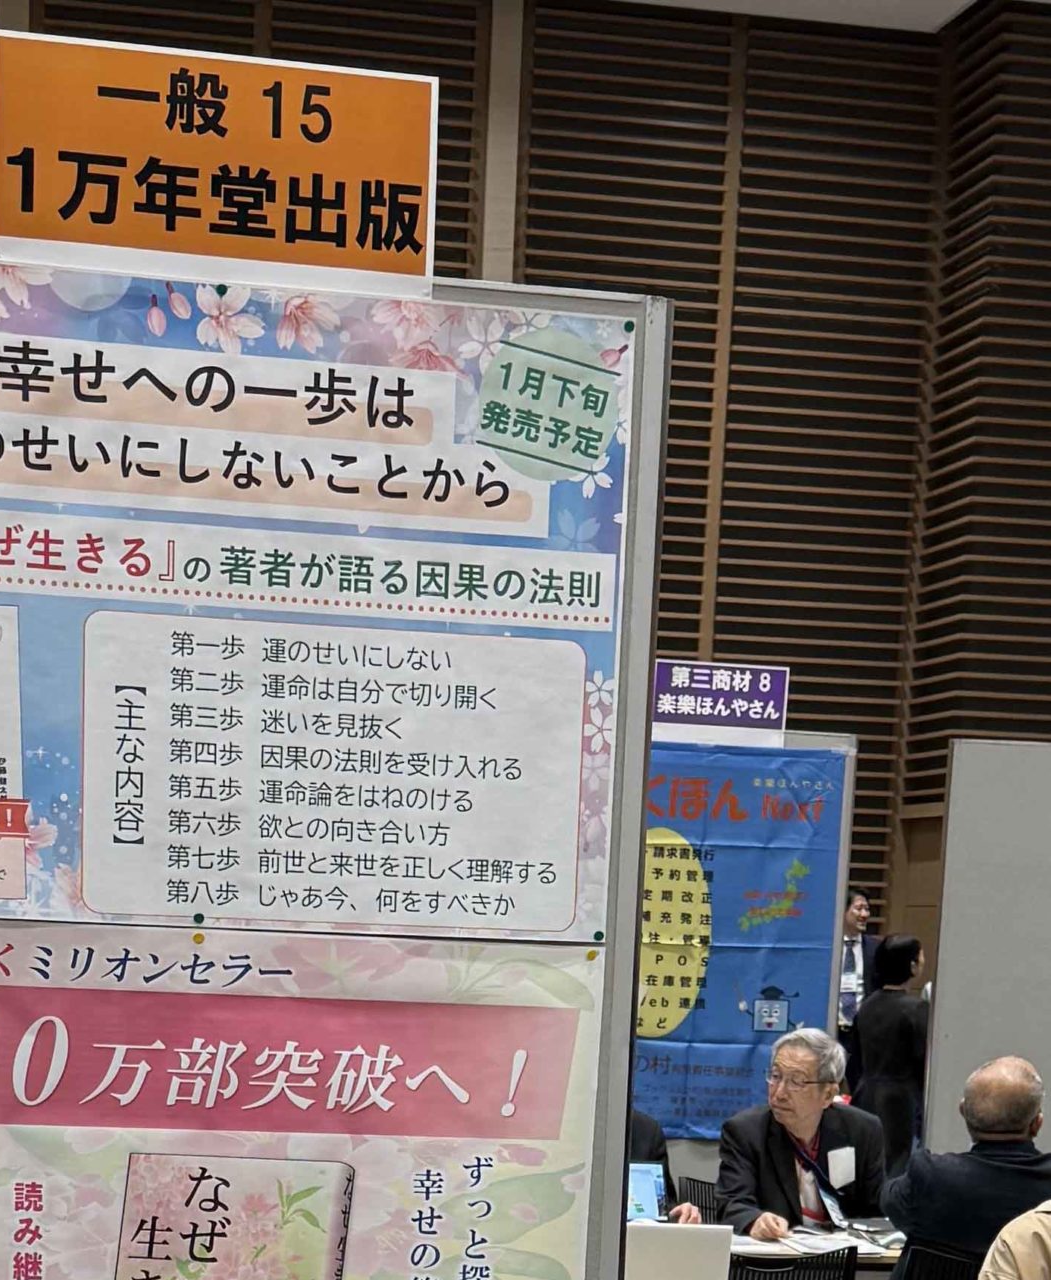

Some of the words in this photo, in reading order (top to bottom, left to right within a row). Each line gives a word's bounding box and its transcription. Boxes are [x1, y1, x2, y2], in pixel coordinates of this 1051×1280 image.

[96, 66, 229, 139] 一般
[261, 82, 333, 142] 15
[6, 148, 424, 256] 1万年堂出版
[497, 362, 609, 418] 1月下旬
[480, 400, 604, 459] 発売予定
[171, 630, 245, 659] 第一歩
[262, 638, 451, 671] 運のせいにしない
[170, 667, 244, 695] 第二歩
[261, 673, 497, 710] 運命は自分で切り開く
[671, 666, 751, 693] 第三商材
[759, 674, 771, 693] 8
[169, 703, 243, 731] 第三歩
[260, 709, 402, 739] 迷いを見抜く
[657, 694, 780, 720] 楽樂ほんやさん
[113, 685, 147, 844] 【主な内容】
[169, 738, 242, 766] 第四歩
[260, 745, 522, 780] 因果の法則を受け入れる
[168, 774, 242, 801] 第五歩
[259, 780, 473, 812] 運命論をはねのける
[762, 793, 825, 822] Next
[168, 809, 241, 836] 第六歩
[259, 814, 450, 847] 欲との向き合い方
[167, 844, 240, 871] 第七歩
[258, 848, 557, 884] 前世と来世を正しく理解する
[652, 868, 713, 883] 予約管理
[166, 879, 239, 906] 第八歩
[259, 885, 515, 916] じゃあ今、何をすべきか
[641, 932, 711, 946] 注・管理
[655, 955, 709, 967] POS
[646, 975, 707, 988] 在庫管理
[179, 1167, 231, 1263] なぜ
